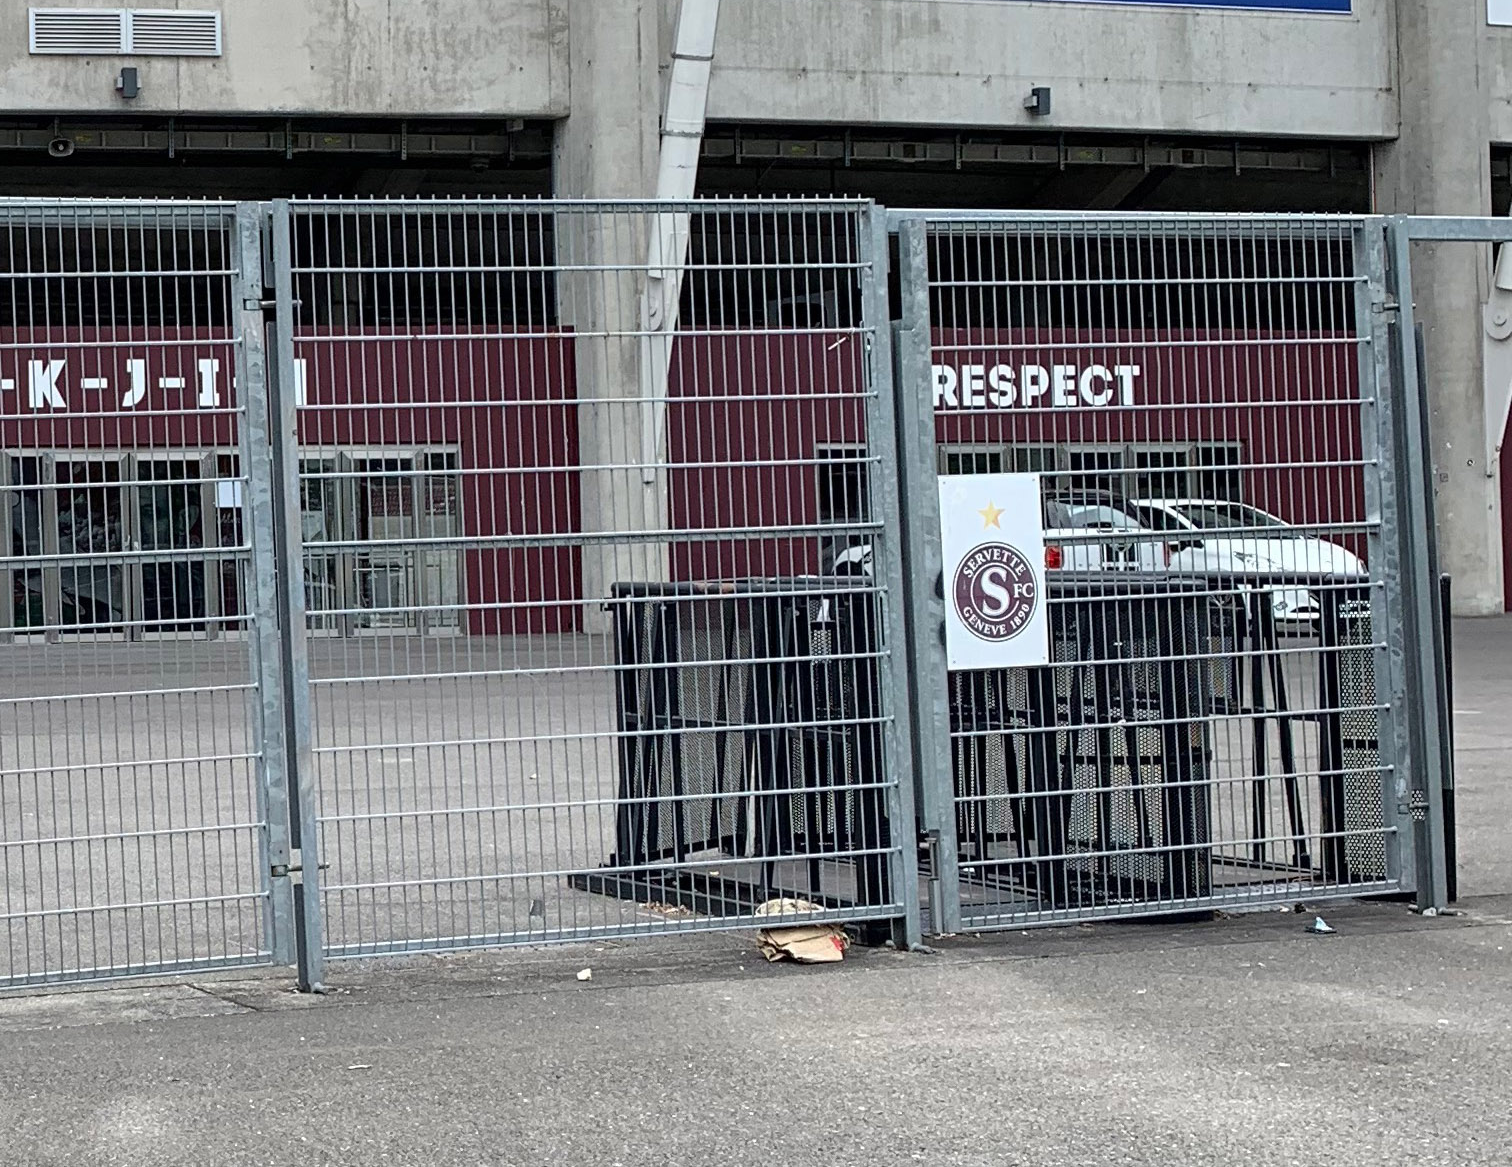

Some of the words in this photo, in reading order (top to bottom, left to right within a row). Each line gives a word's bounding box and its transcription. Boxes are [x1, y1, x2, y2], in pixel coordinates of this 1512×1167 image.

[931, 364, 1140, 408] RESPECT
[963, 547, 1027, 579] SERVETTE
[980, 566, 1010, 617] S
[1013, 582, 1034, 599] FC
[963, 606, 1007, 636] GENEVE
[1010, 604, 1030, 631] 1890
